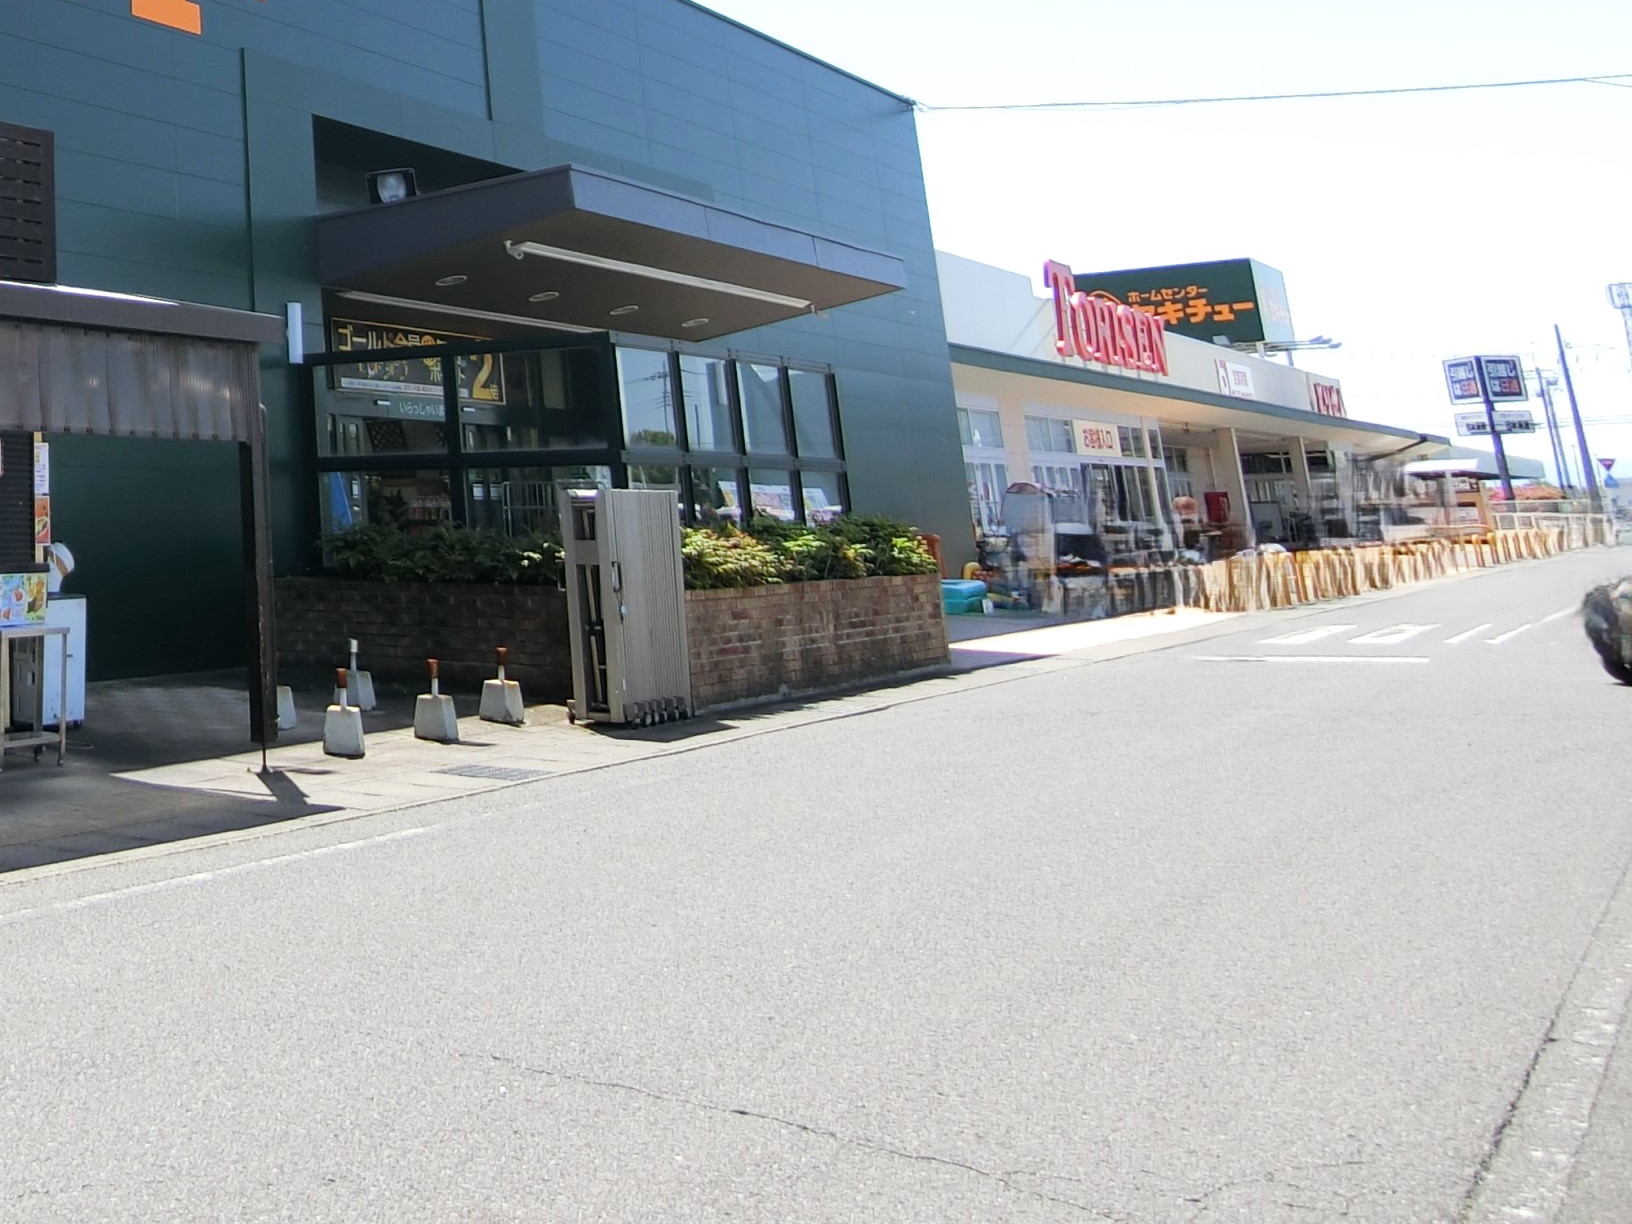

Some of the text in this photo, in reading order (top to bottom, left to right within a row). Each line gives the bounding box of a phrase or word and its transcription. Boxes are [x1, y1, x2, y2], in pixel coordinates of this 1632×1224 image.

[1127, 284, 1208, 303] ホームセンター
[1044, 259, 1169, 376] TORISEN
[1082, 428, 1114, 450] お客様入口
